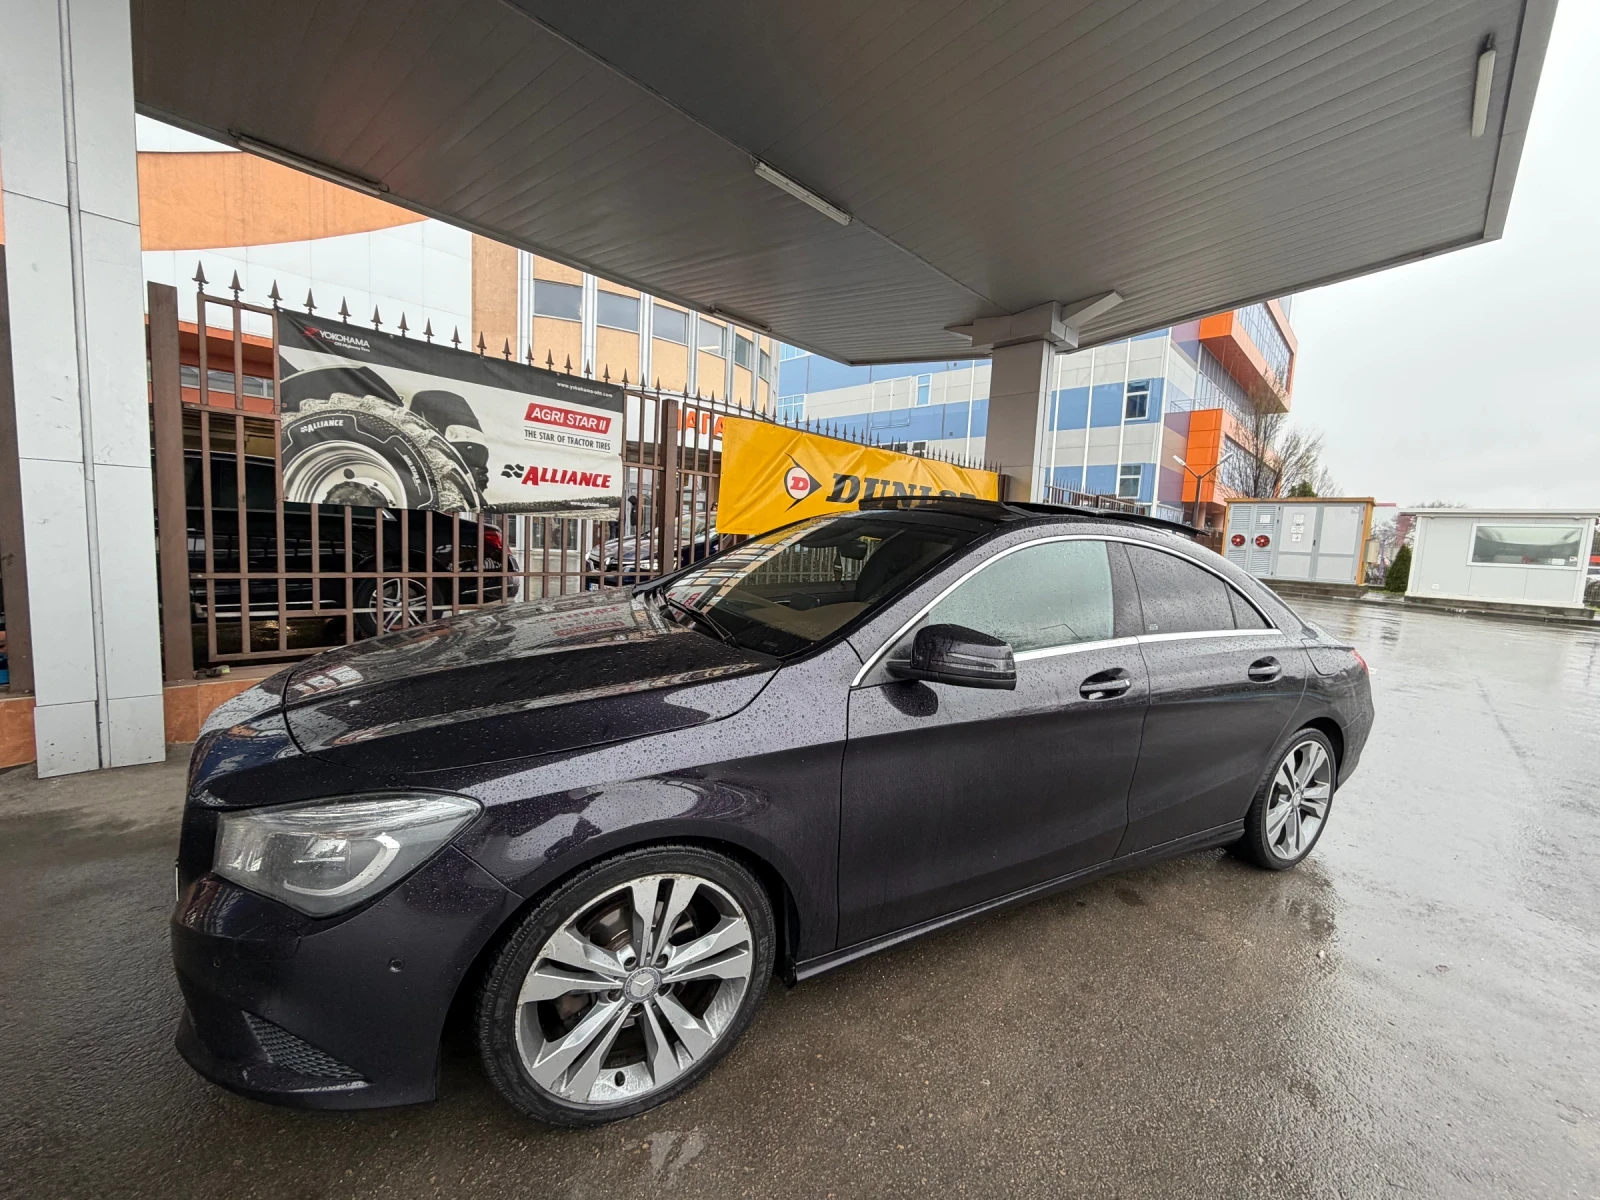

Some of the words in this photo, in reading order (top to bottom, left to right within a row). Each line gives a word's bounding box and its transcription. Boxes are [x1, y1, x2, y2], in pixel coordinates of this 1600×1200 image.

[319, 330, 370, 348] YOKOHAMA
[308, 419, 344, 432] ALLIANCE
[531, 407, 564, 424] AGRI
[566, 413, 597, 429] STAR
[598, 419, 607, 431] II
[524, 429, 537, 439] THE
[539, 431, 555, 441] STAR
[556, 434, 566, 443] OF
[567, 436, 594, 448] TRACTOR
[595, 440, 611, 451] TIRES
[521, 465, 612, 488] ALLIANCE
